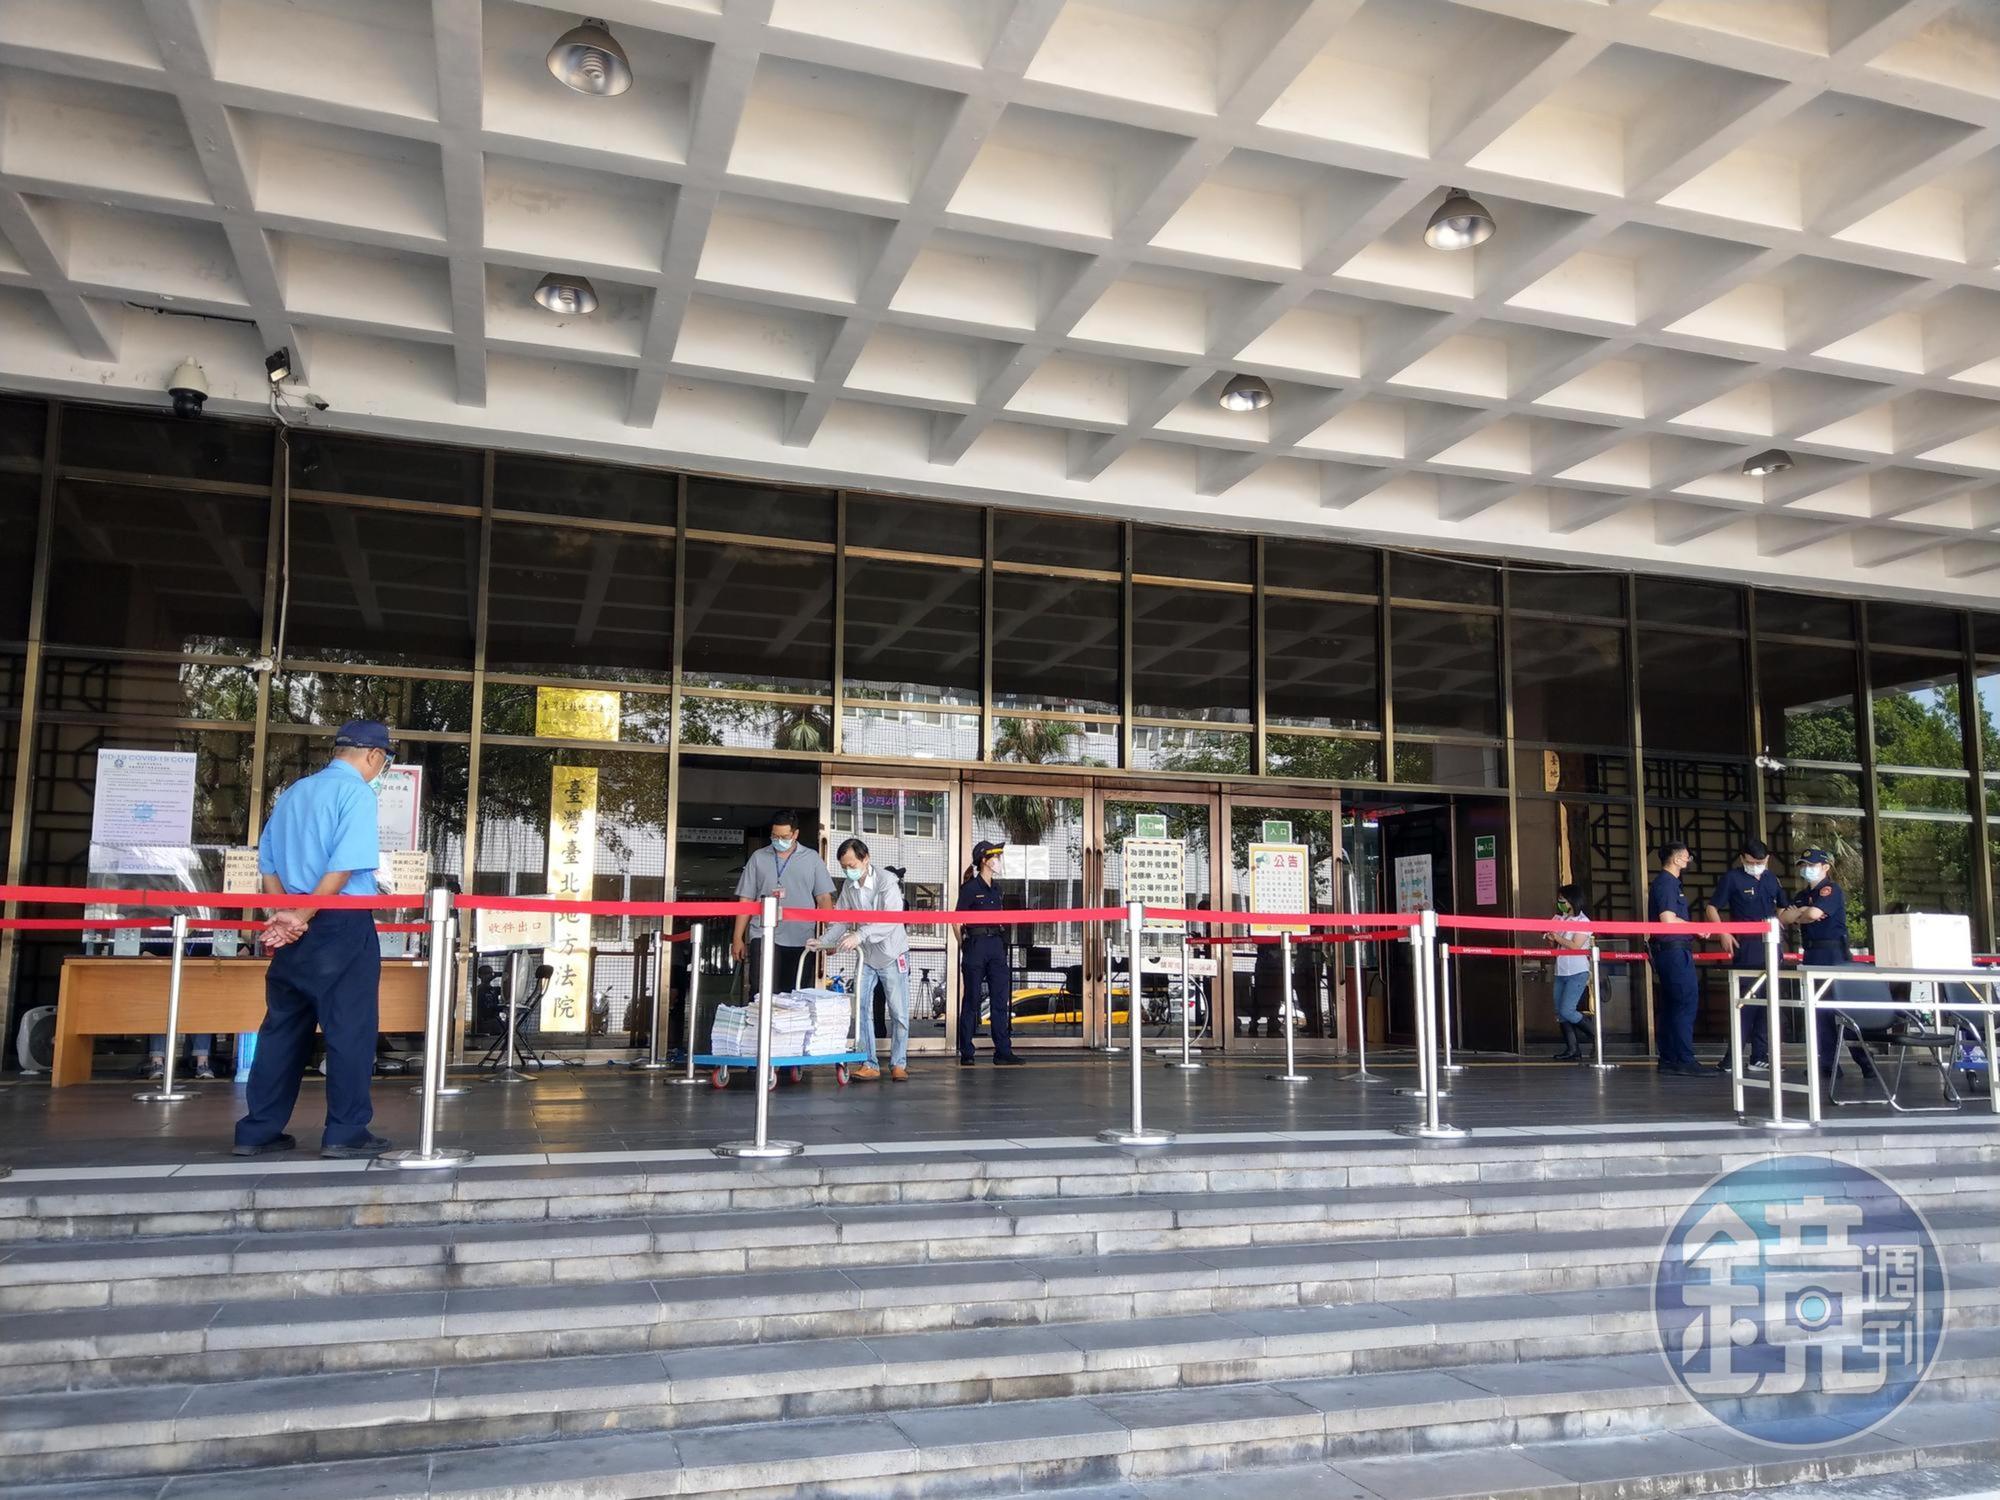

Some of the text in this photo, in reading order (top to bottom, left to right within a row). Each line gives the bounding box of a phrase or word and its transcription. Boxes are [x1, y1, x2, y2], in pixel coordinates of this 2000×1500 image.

[1270, 828, 1287, 836] 入口
[1274, 854, 1298, 868] 公告
[488, 920, 542, 934] 收件出口
